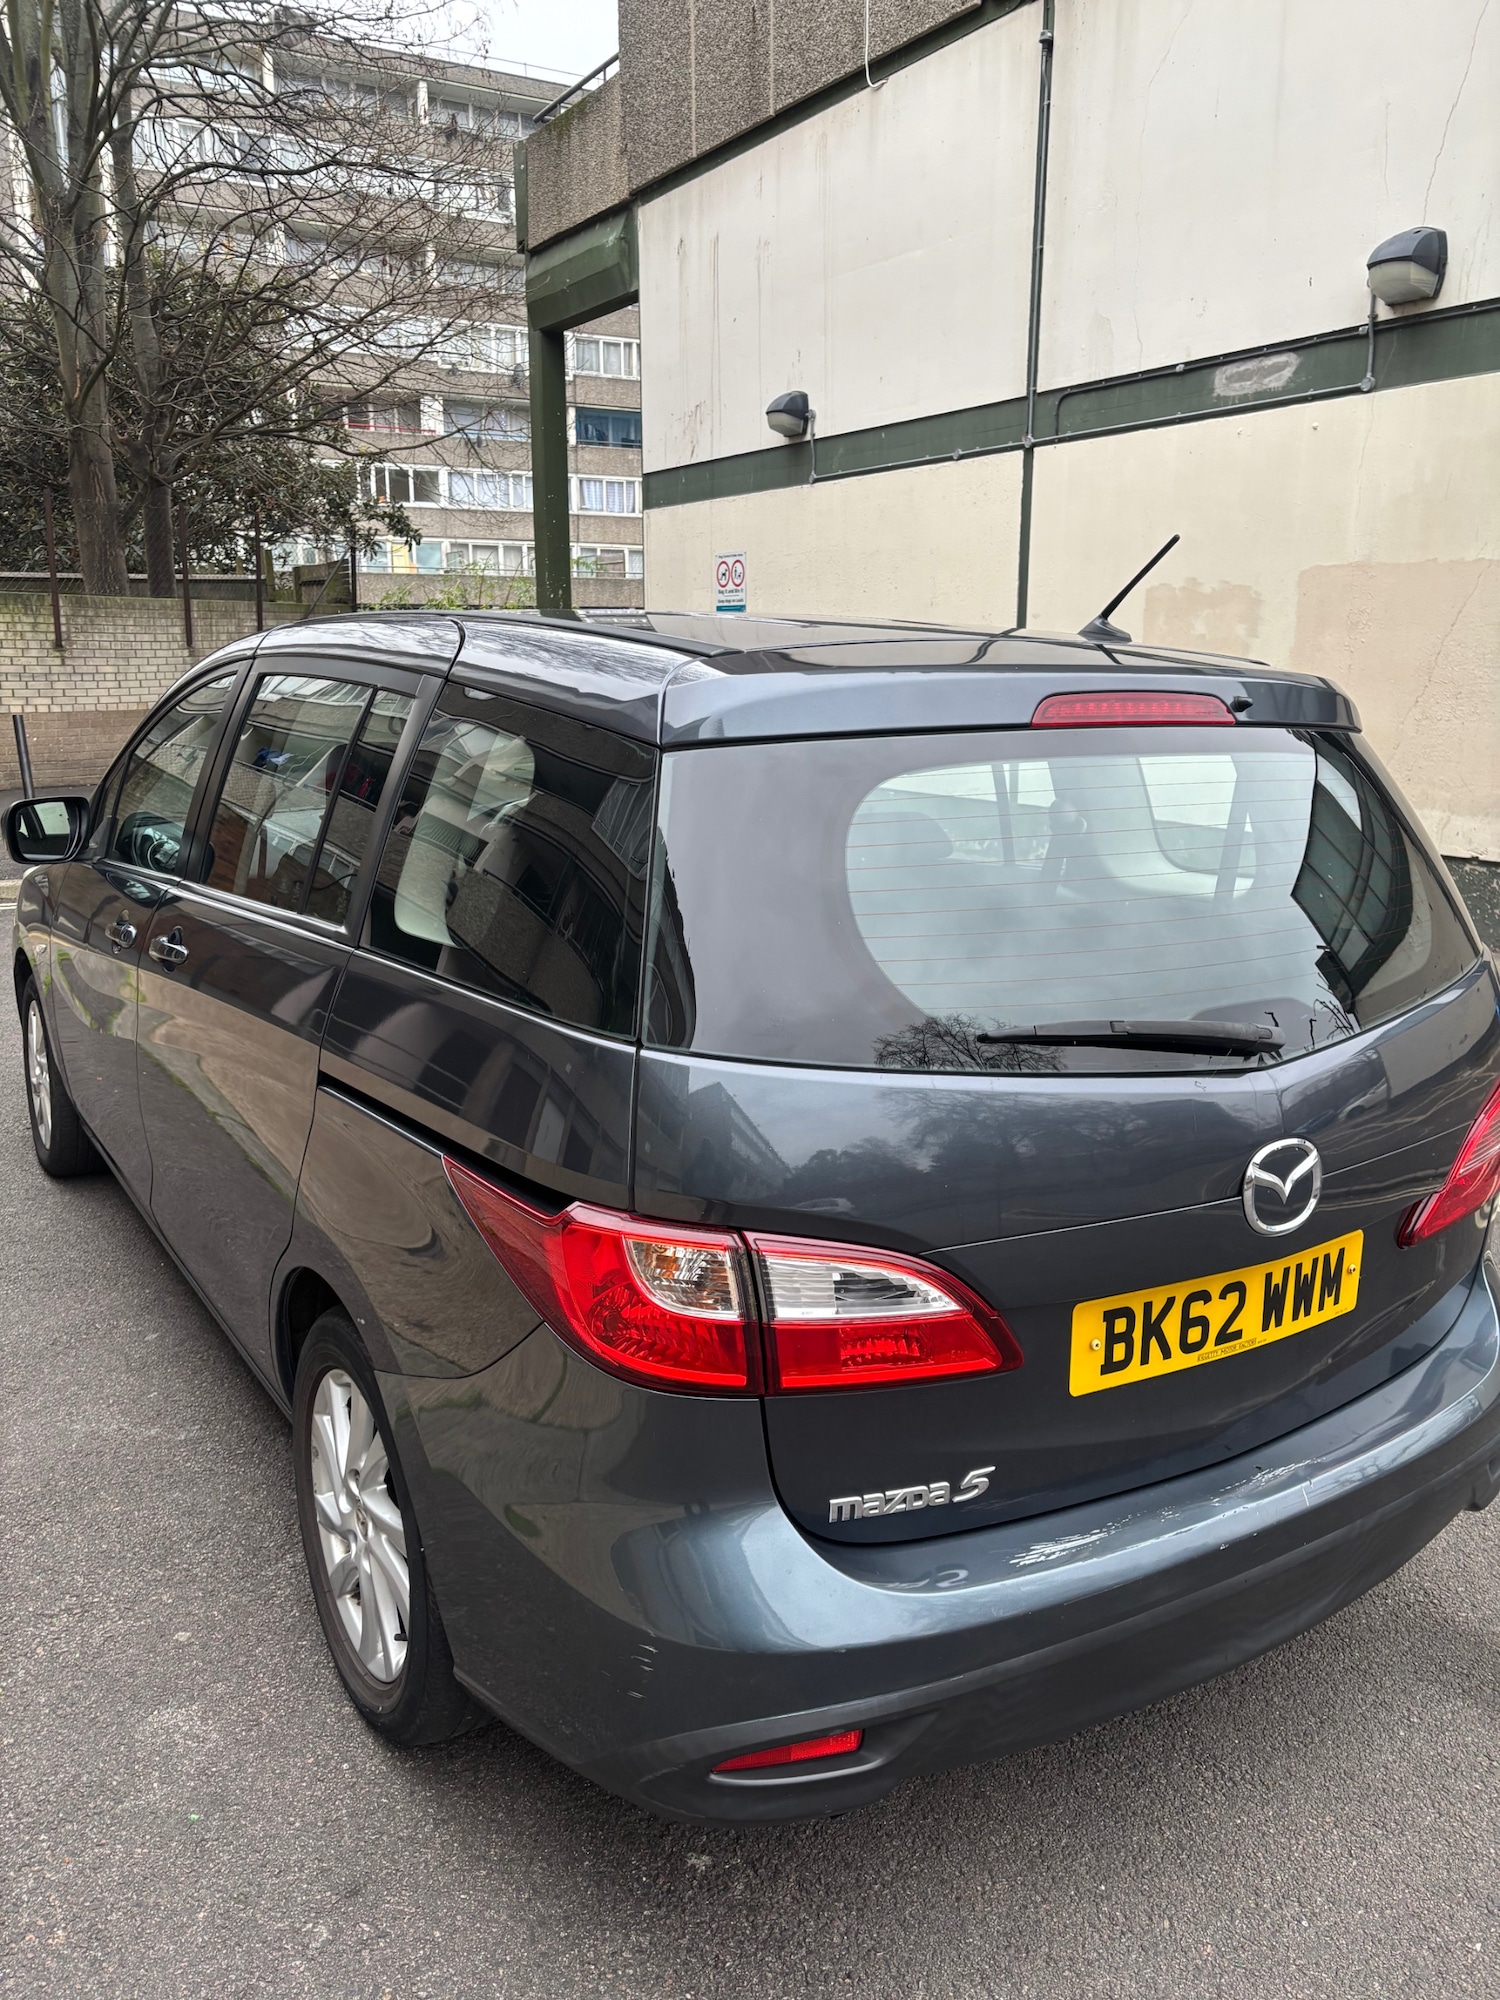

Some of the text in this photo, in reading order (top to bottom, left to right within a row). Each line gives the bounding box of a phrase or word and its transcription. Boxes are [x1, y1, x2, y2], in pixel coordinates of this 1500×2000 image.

[1100, 1247, 1346, 1376] BK62 WWM
[1220, 1343, 1237, 1356] MOTOR
[952, 1465, 996, 1503] 5
